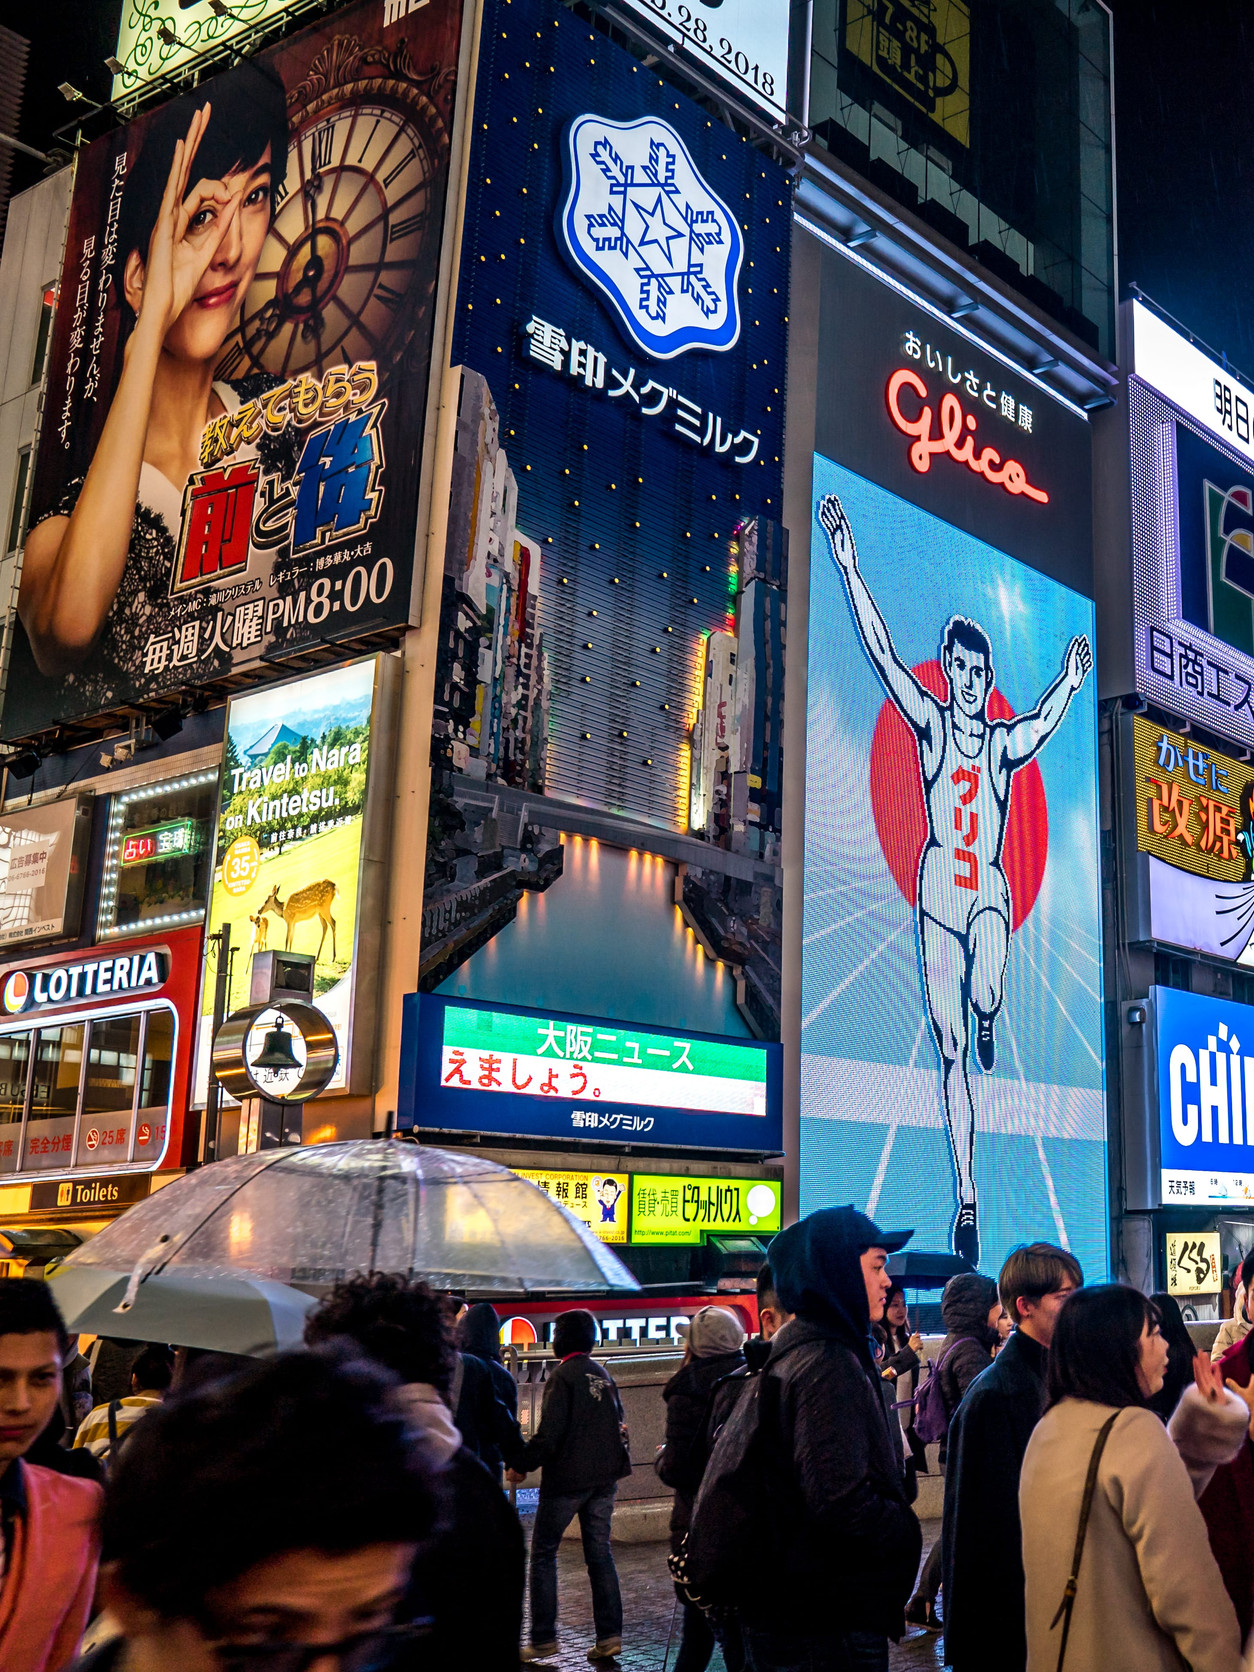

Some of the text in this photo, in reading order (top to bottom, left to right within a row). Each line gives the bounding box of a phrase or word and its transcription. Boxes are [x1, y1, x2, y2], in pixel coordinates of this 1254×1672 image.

[84, 151, 127, 402] 見た目は変わりませんが、
[58, 235, 96, 449] 見る目が変わります。
[526, 314, 760, 464] 雪印メグミルク
[904, 330, 1033, 434] おいしさと健康
[199, 362, 378, 467] 教えてもらう
[886, 369, 1050, 504] Glico
[170, 398, 387, 596] 前と後
[143, 599, 264, 674] 毎週火曜
[231, 743, 361, 793] Travel to Nara
[1157, 735, 1229, 794] かぜに
[226, 786, 340, 830] on Kintetsu.
[951, 764, 980, 891] グリコ
[1150, 778, 1240, 860] 改源
[230, 856, 250, 878] 35
[34, 952, 159, 1002] LOTTERIA
[536, 1021, 694, 1070] 大阪ニュース
[443, 1050, 602, 1098] えましょう。
[29, 1134, 72, 1155] 完全分煙
[101, 1128, 127, 1146] 25席
[571, 1110, 655, 1131] 雪印メグミルク
[76, 1183, 119, 1203] Toilets
[545, 1173, 589, 1182] CORPORATION
[637, 1188, 679, 1217] 賃貸・売買
[1168, 1180, 1196, 1195] 天気予報
[682, 1184, 742, 1223] ピタットハウス
